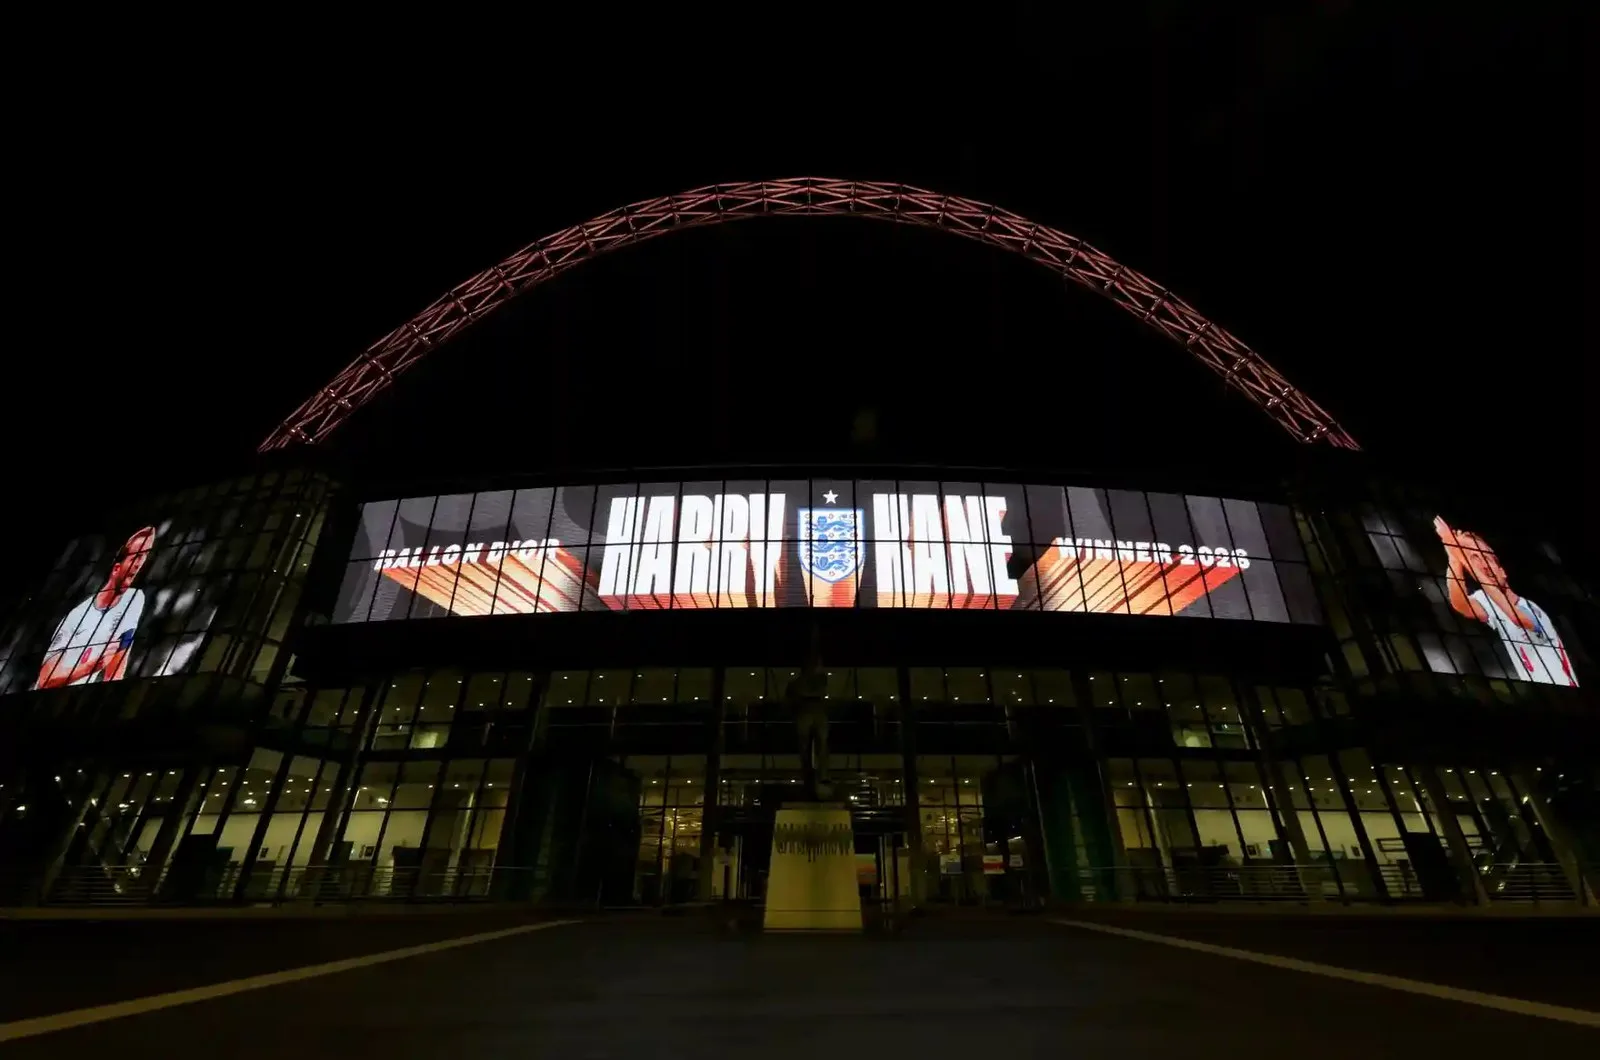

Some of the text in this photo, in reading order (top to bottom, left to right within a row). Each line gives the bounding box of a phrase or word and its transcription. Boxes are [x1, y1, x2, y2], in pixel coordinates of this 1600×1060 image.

[374, 543, 484, 570] BALLON
[598, 493, 1019, 596] HARRY KANE
[1056, 537, 1173, 564] WINNER
